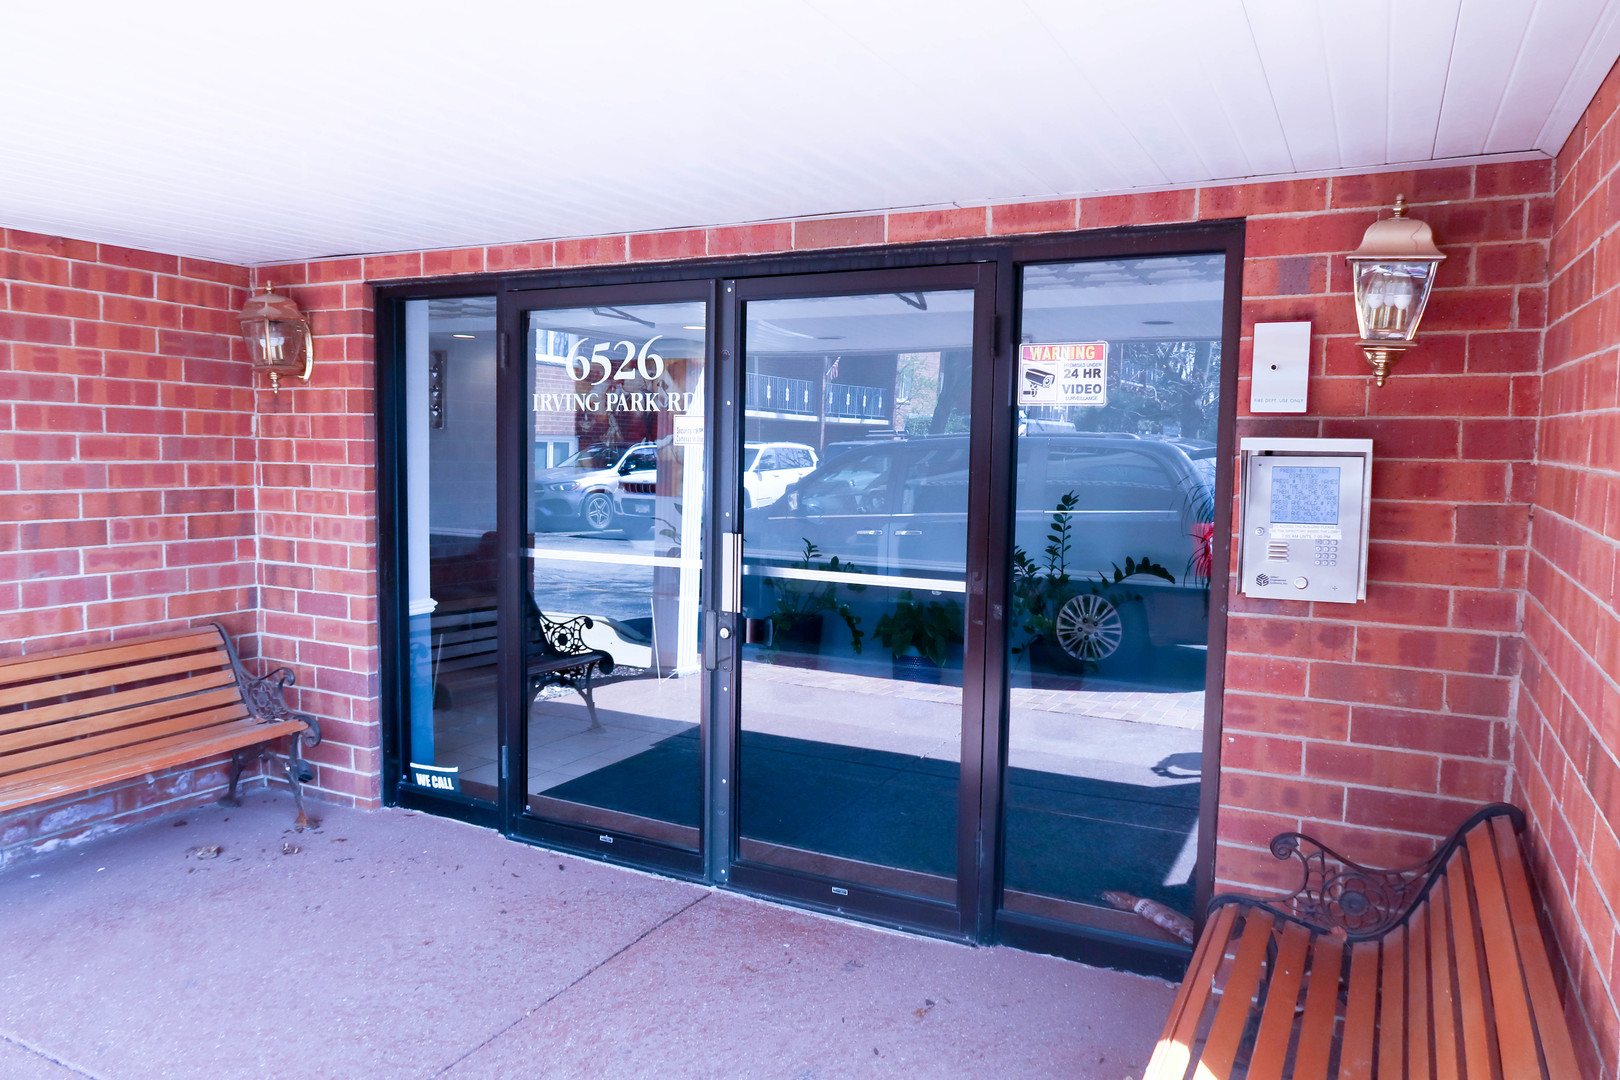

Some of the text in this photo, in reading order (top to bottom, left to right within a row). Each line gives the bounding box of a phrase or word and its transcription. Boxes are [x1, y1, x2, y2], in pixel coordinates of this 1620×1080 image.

[565, 335, 665, 386] 6526
[1030, 345, 1096, 360] WARNING
[1064, 368, 1102, 379] 24 HR
[1062, 384, 1102, 394] VIDEO
[532, 393, 600, 412] IRVING
[606, 392, 660, 412] PARK
[416, 773, 454, 790] WE CALL
